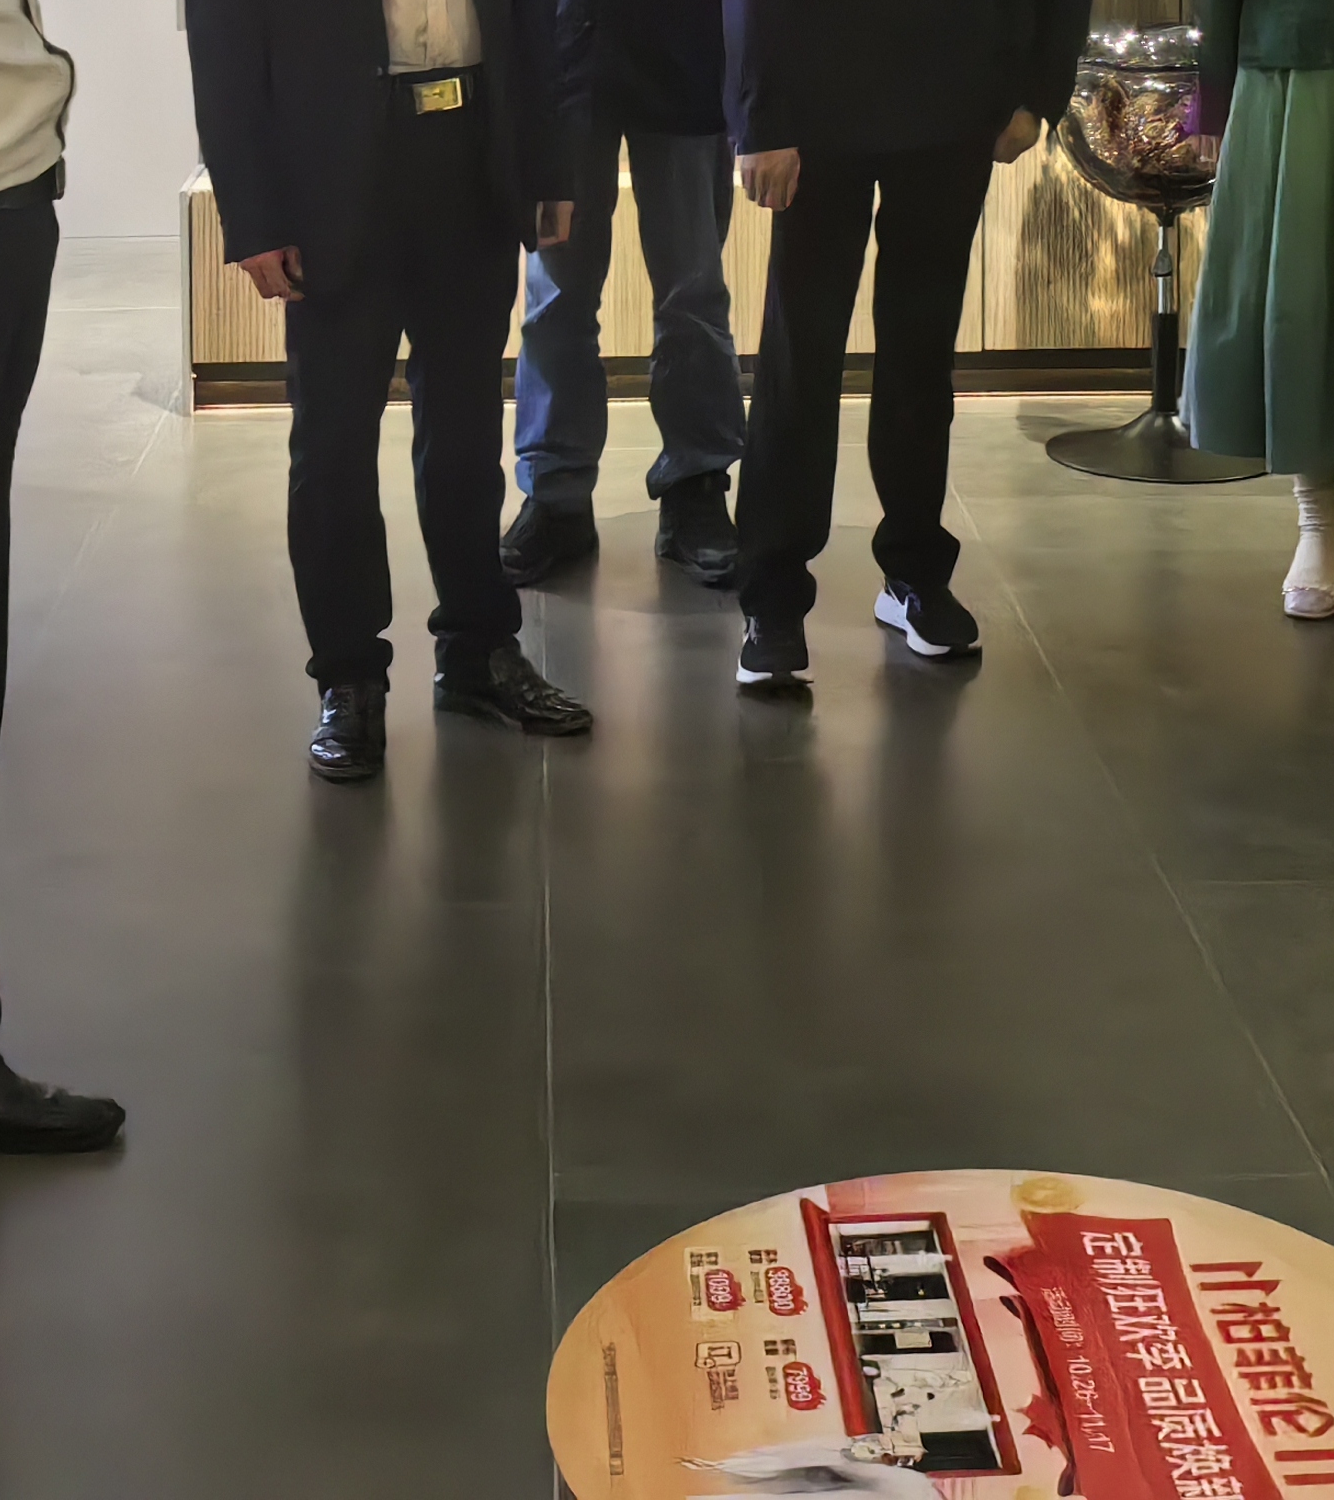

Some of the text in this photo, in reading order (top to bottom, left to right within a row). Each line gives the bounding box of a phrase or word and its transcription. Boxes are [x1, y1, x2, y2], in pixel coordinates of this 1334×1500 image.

[1079, 1231, 1193, 1372] 定制狂欢季
